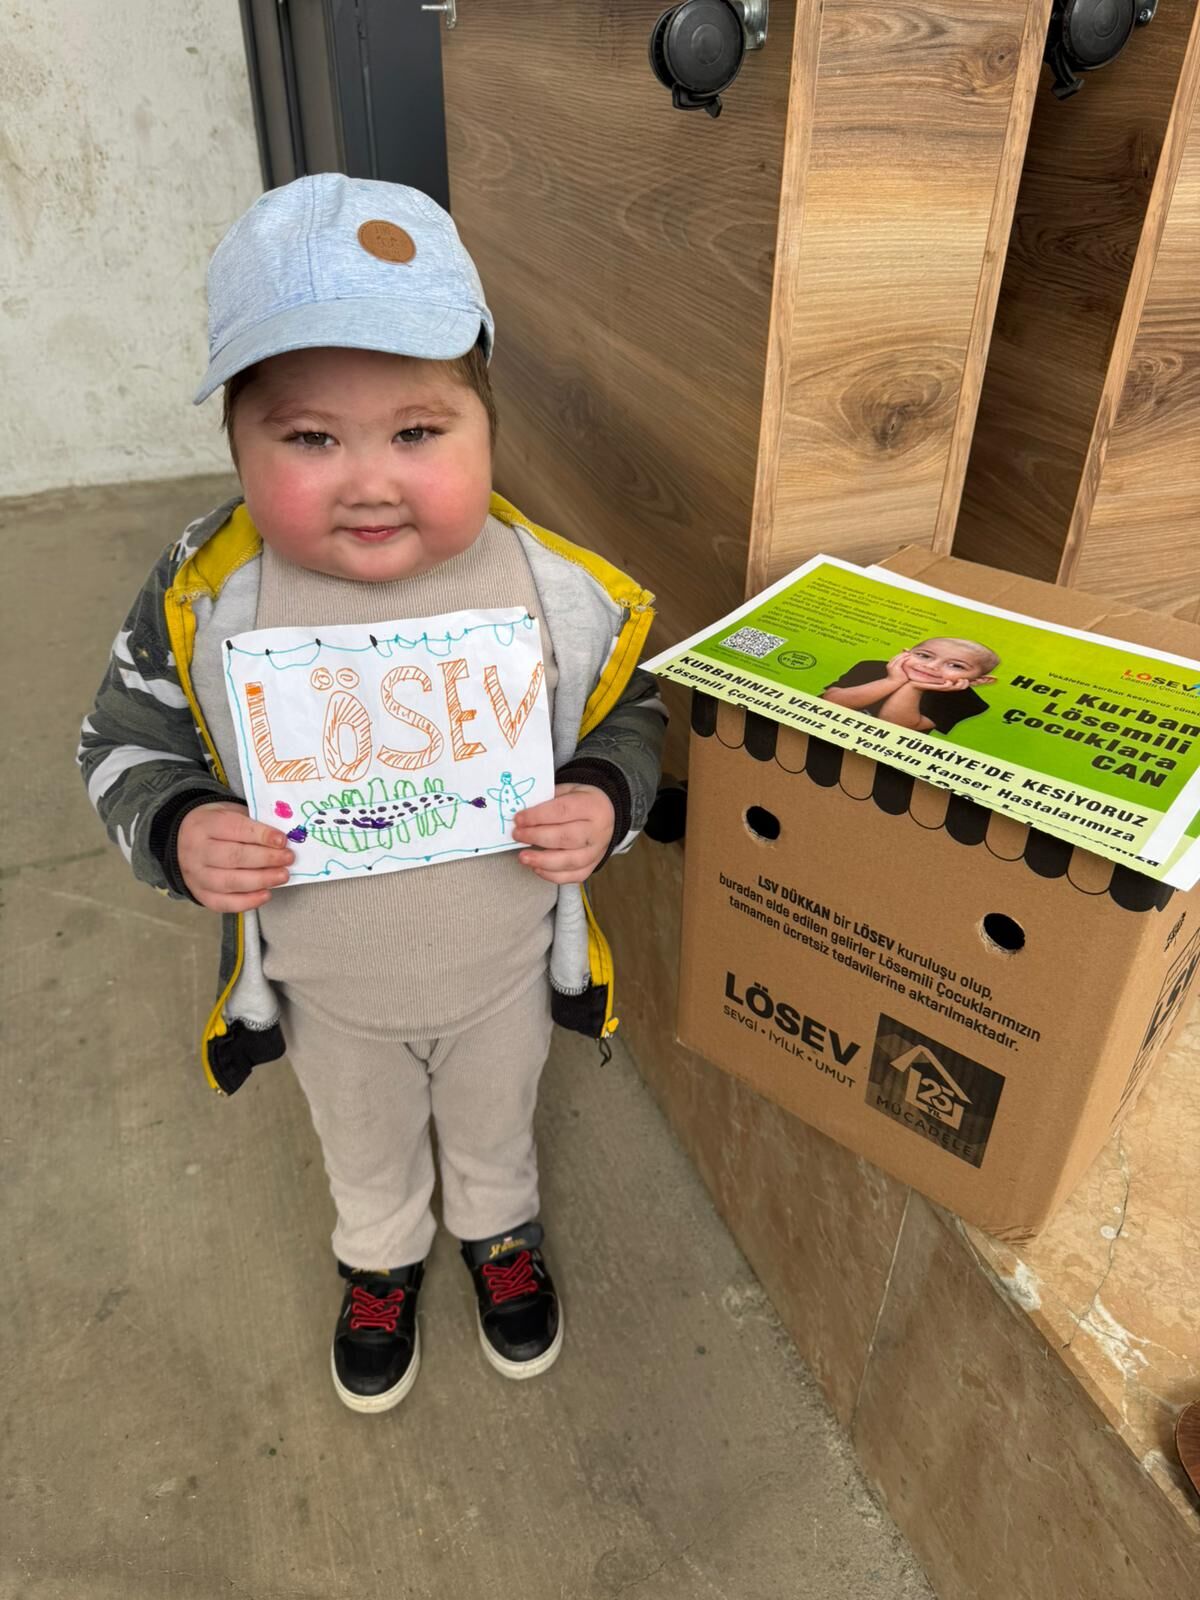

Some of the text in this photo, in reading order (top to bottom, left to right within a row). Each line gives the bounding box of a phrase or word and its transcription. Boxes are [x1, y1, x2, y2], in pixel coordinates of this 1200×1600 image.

[245, 658, 545, 783] LÖSEV
[679, 656, 785, 699] KURBANINIZI
[788, 696, 890, 739] VEKALETEN
[895, 734, 1016, 783] TÜRKİYE'DE
[1021, 778, 1149, 828] KESİYORUZ
[1002, 708, 1177, 771] Çocuklara
[1009, 674, 1200, 738] Her Kurban
[1042, 702, 1192, 755] Lösemili
[1093, 684, 1124, 697] kurban
[1126, 693, 1171, 709] kesiyoruz
[665, 665, 727, 691] Lösemili
[727, 688, 827, 730] Çocuklarımız
[830, 727, 850, 740] ve
[855, 735, 922, 767] Yetişkin
[926, 763, 993, 792] Kanser
[996, 788, 1136, 843] Hastalarımıza
[1091, 754, 1168, 788] CAN
[719, 871, 1041, 1042] buradan elde edilen gelirler Lösemili Çocuklarımızın
[729, 895, 1020, 1052] tamamen ücretsiz tedavilerine aktarılmaktadır.
[758, 874, 994, 1001] LSV DÜKKAN bir LÖSEV kuruluşu olup,
[723, 1004, 759, 1033] SEVGİ
[814, 1058, 857, 1089] UMUT
[724, 970, 862, 1067] LÖSEV
[927, 1105, 942, 1120] YIL
